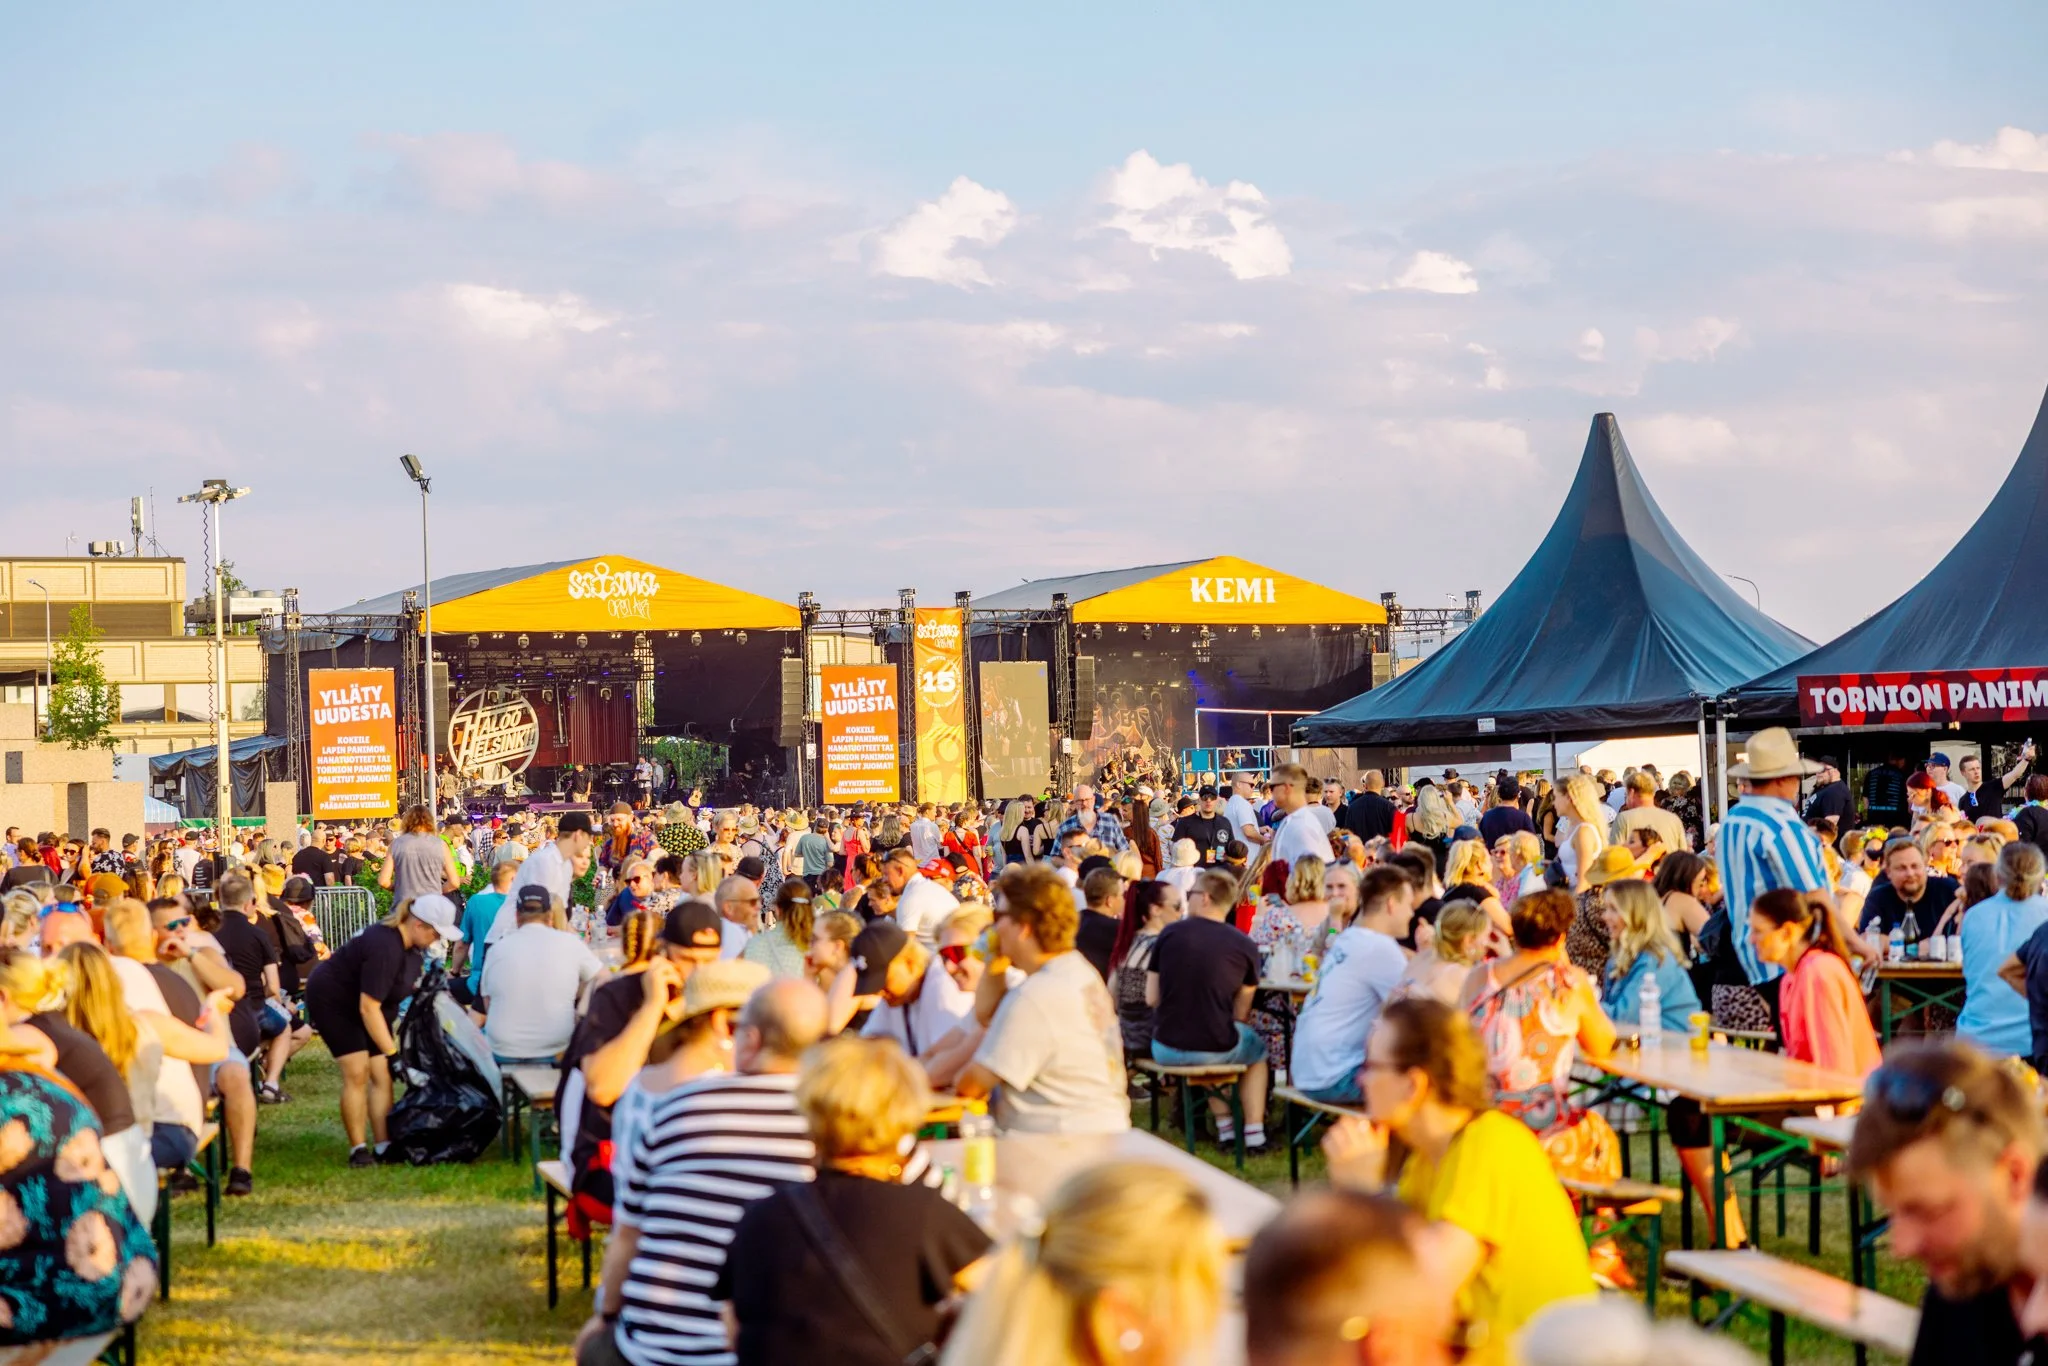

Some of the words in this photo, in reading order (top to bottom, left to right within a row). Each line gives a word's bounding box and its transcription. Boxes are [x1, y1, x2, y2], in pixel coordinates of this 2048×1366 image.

[1190, 577, 1276, 603] KEMI
[923, 671, 955, 692] 15
[830, 677, 886, 698] YLLÄTY
[320, 684, 382, 706] YLLÄTY
[1810, 684, 1943, 713] TORNION
[825, 696, 895, 716] UUDESTA
[314, 703, 392, 725] UUDESTA
[845, 726, 875, 734] KOKEILE
[337, 736, 370, 744] KOKEILE
[855, 735, 889, 743] PANIMON
[322, 746, 346, 754] LAPIN
[347, 745, 385, 753] PANIMON
[377, 754, 390, 762] TAI
[827, 753, 859, 761] TORNION
[861, 752, 895, 761] PANIMON
[316, 765, 352, 774] TORNION
[353, 763, 392, 772] PANIMON
[829, 762, 861, 770] PALKITUT
[862, 761, 894, 770] JUOMAT!
[318, 775, 355, 784] PALKITUT
[356, 773, 391, 783] JUOMAT!
